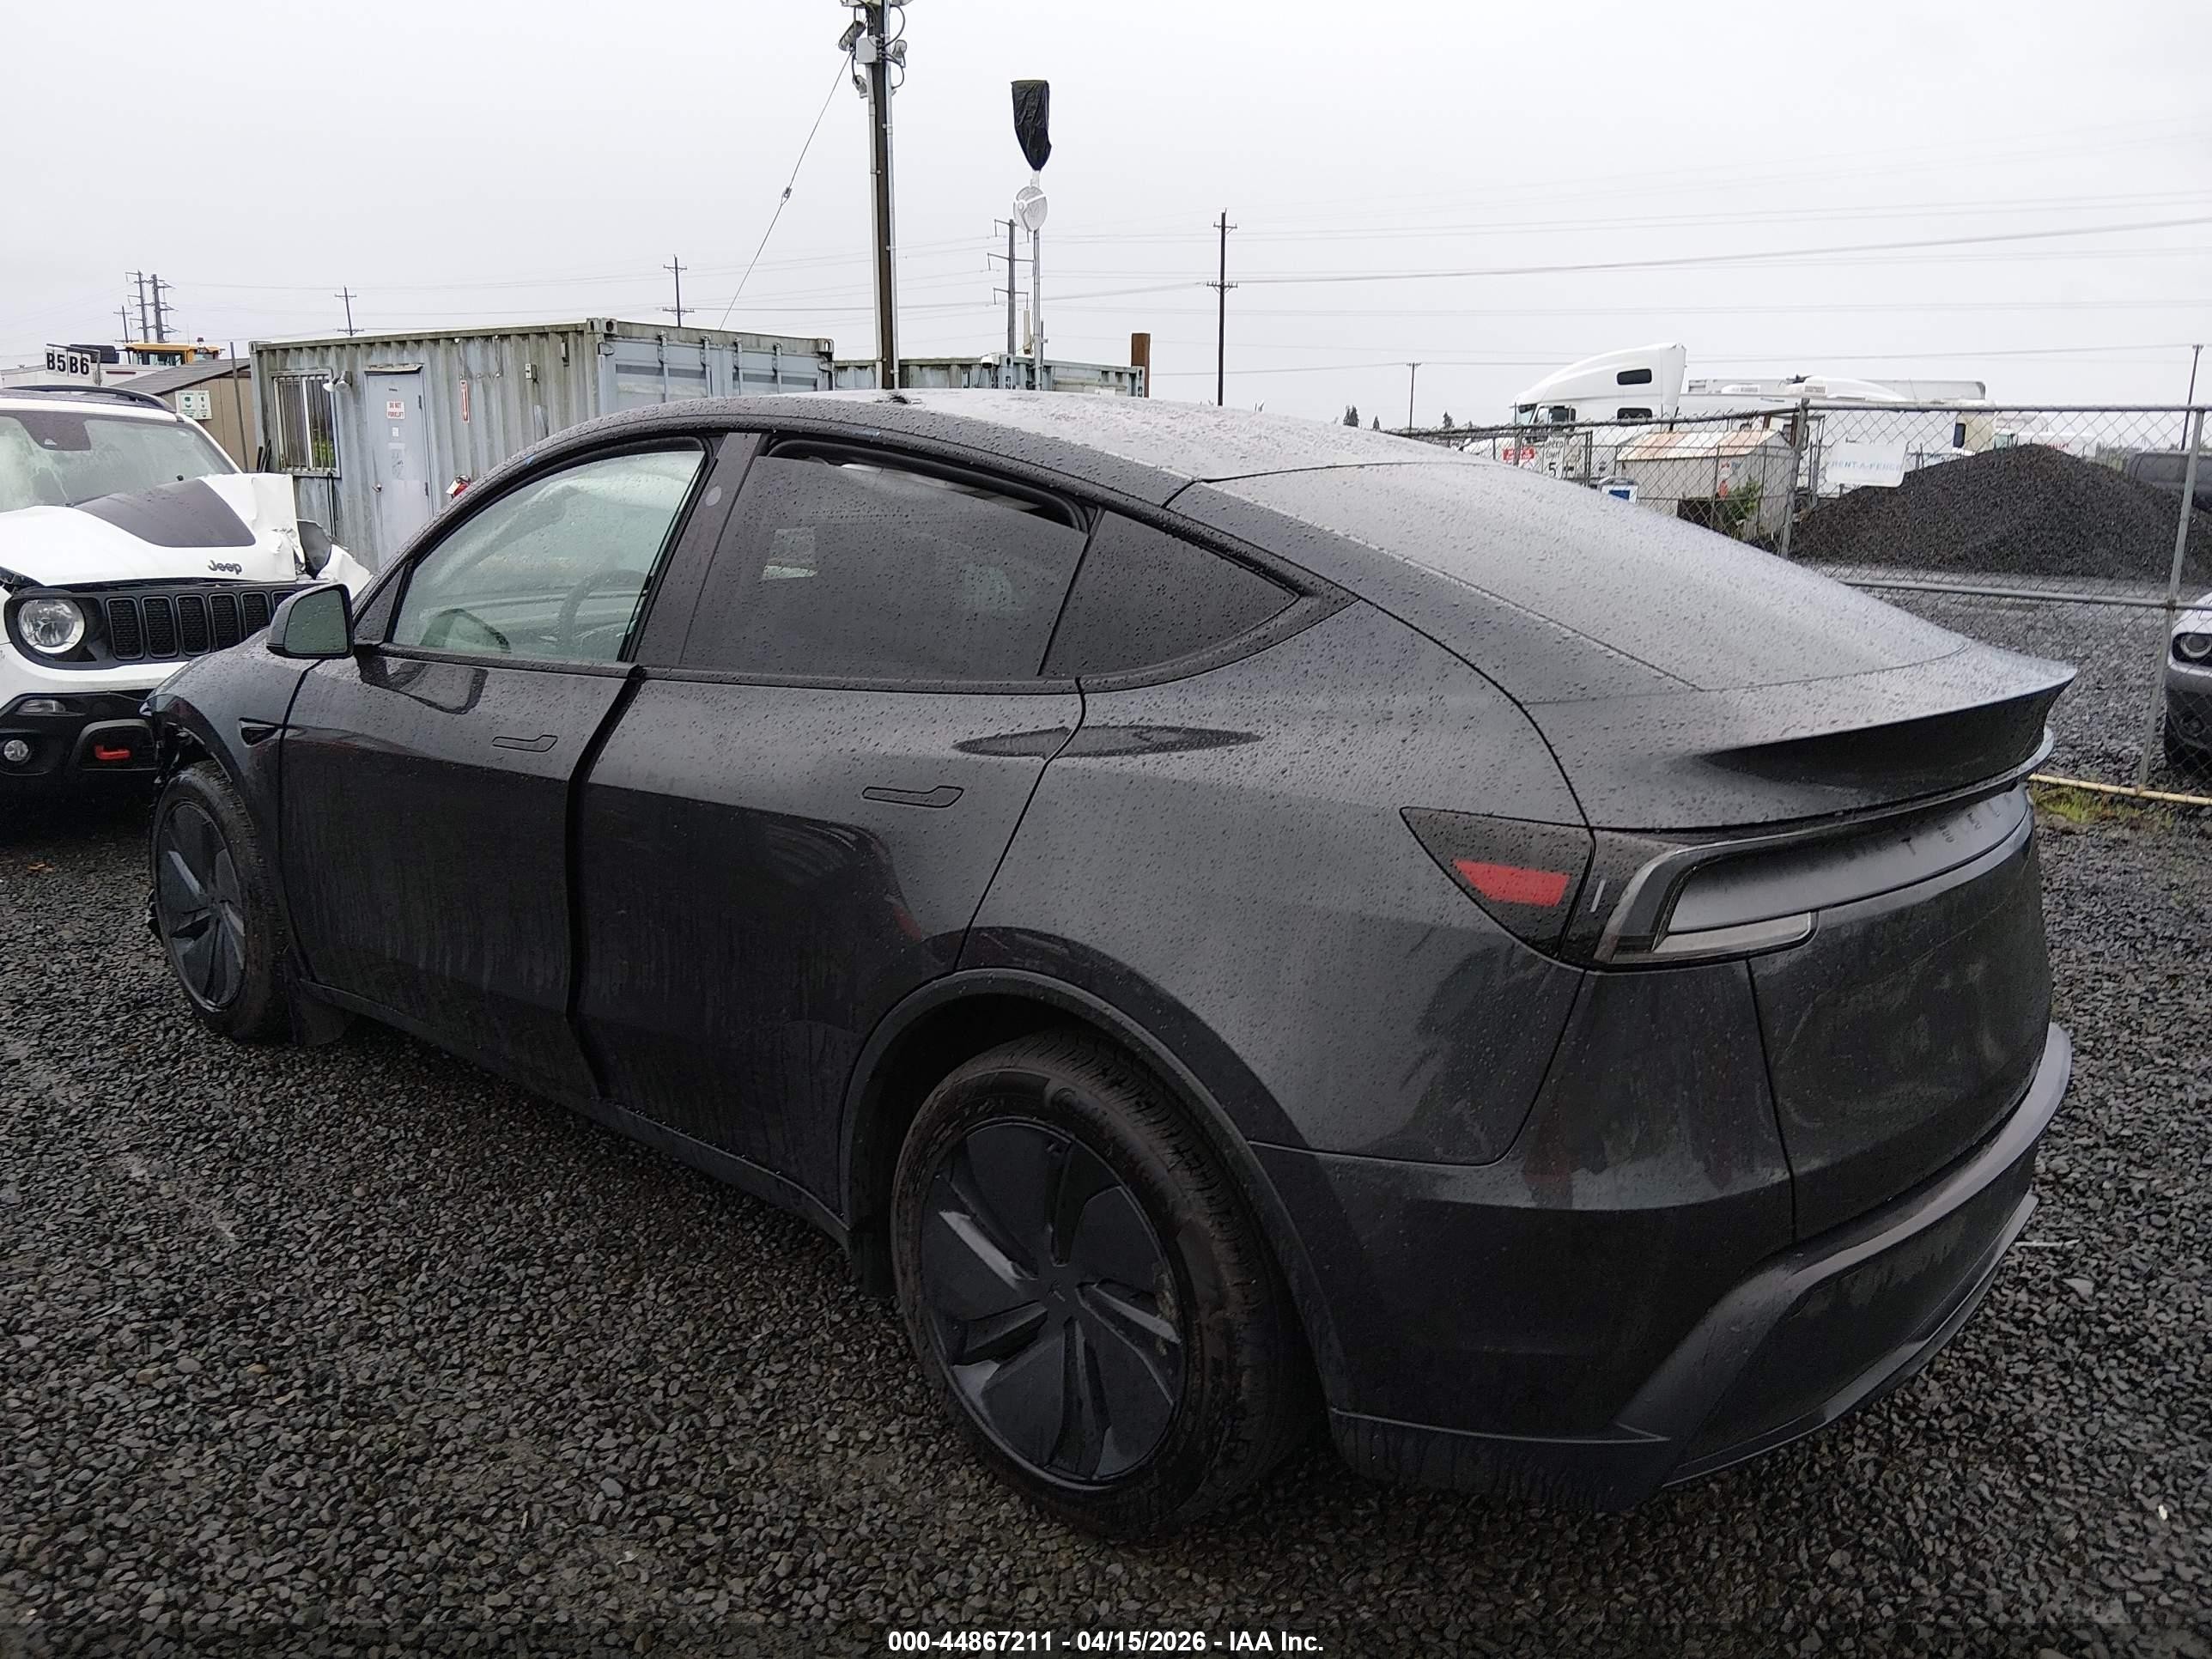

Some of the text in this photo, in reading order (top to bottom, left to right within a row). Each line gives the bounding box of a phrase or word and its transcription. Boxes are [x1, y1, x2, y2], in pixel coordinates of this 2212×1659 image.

[46, 352, 90, 376] B5 B6
[1548, 461, 1557, 477] 5
[207, 559, 243, 575] Jeep
